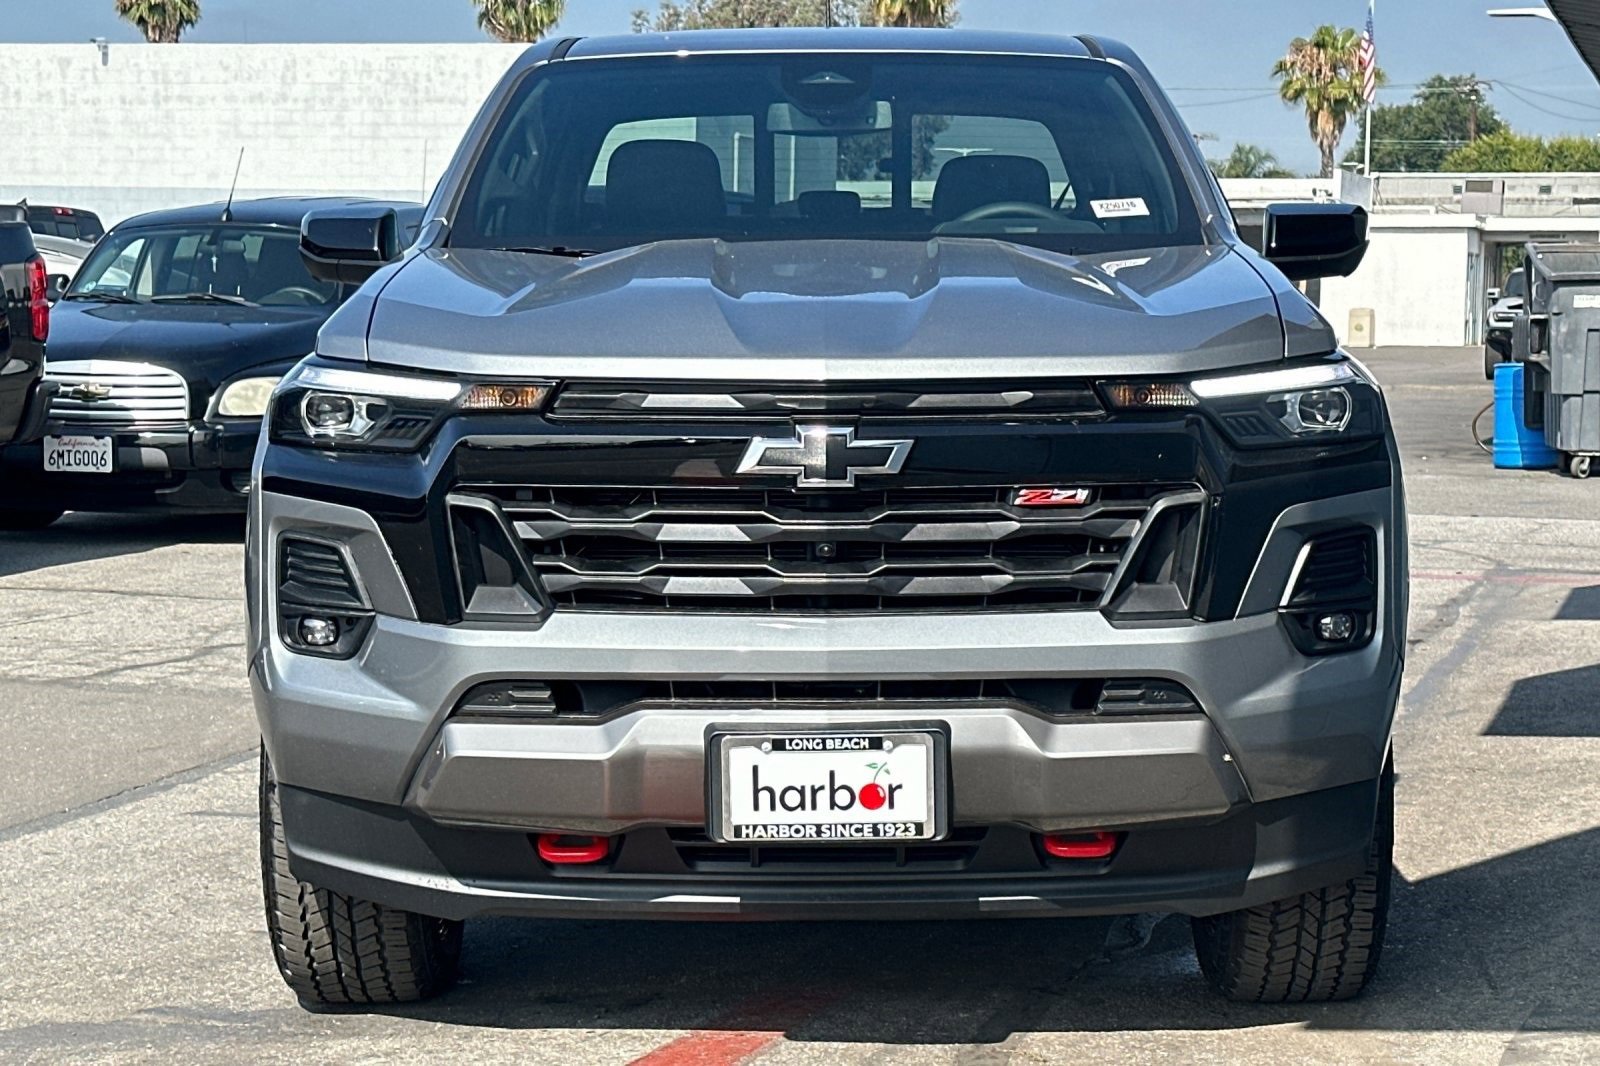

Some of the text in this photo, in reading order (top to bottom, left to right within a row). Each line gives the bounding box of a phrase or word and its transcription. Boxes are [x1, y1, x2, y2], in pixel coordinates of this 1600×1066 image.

[58, 438, 99, 448] California
[1014, 488, 1089, 505] Z71
[785, 738, 869, 750] LONG BEACH
[752, 764, 902, 812] harbor
[741, 823, 916, 838] HARBOR SINCE 1923
